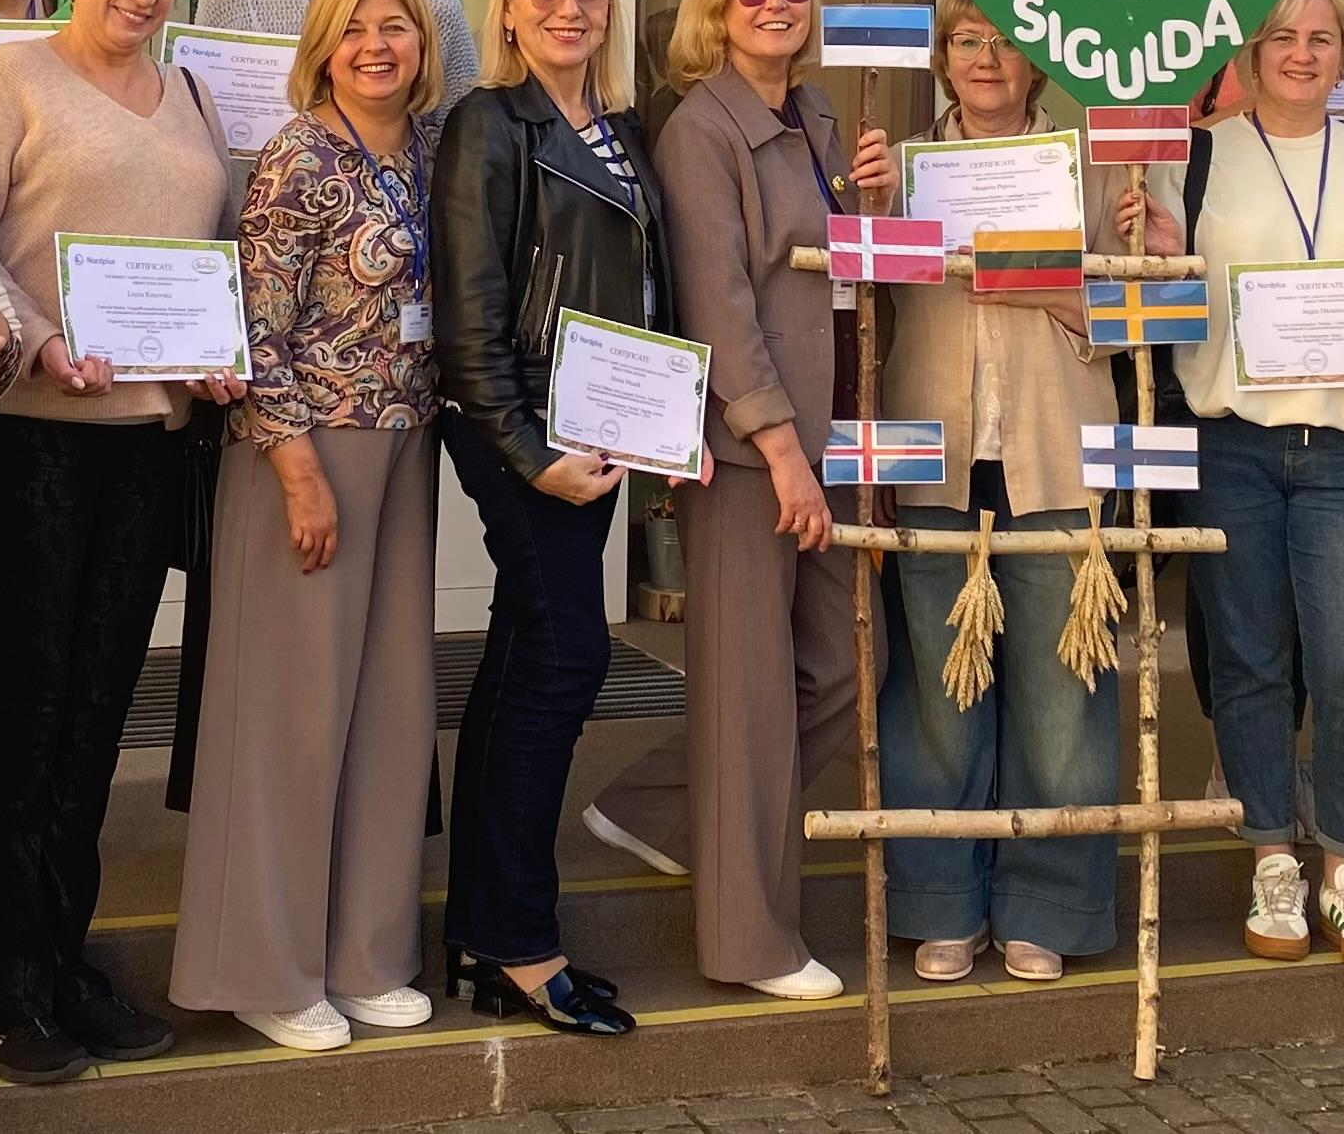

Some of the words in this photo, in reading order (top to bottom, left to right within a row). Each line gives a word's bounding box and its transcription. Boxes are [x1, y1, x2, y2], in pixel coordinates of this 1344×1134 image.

[192, 48, 222, 58] Nordplus
[230, 56, 280, 67] CERTIFICATE
[969, 159, 1017, 170] CERTIFICATE
[86, 256, 116, 267] Nordplus
[125, 262, 175, 271] CERTIFICATE
[1295, 281, 1344, 291] CERTIFICATE
[579, 336, 603, 349] Nordplus
[609, 346, 652, 364] CERTIFICATE
